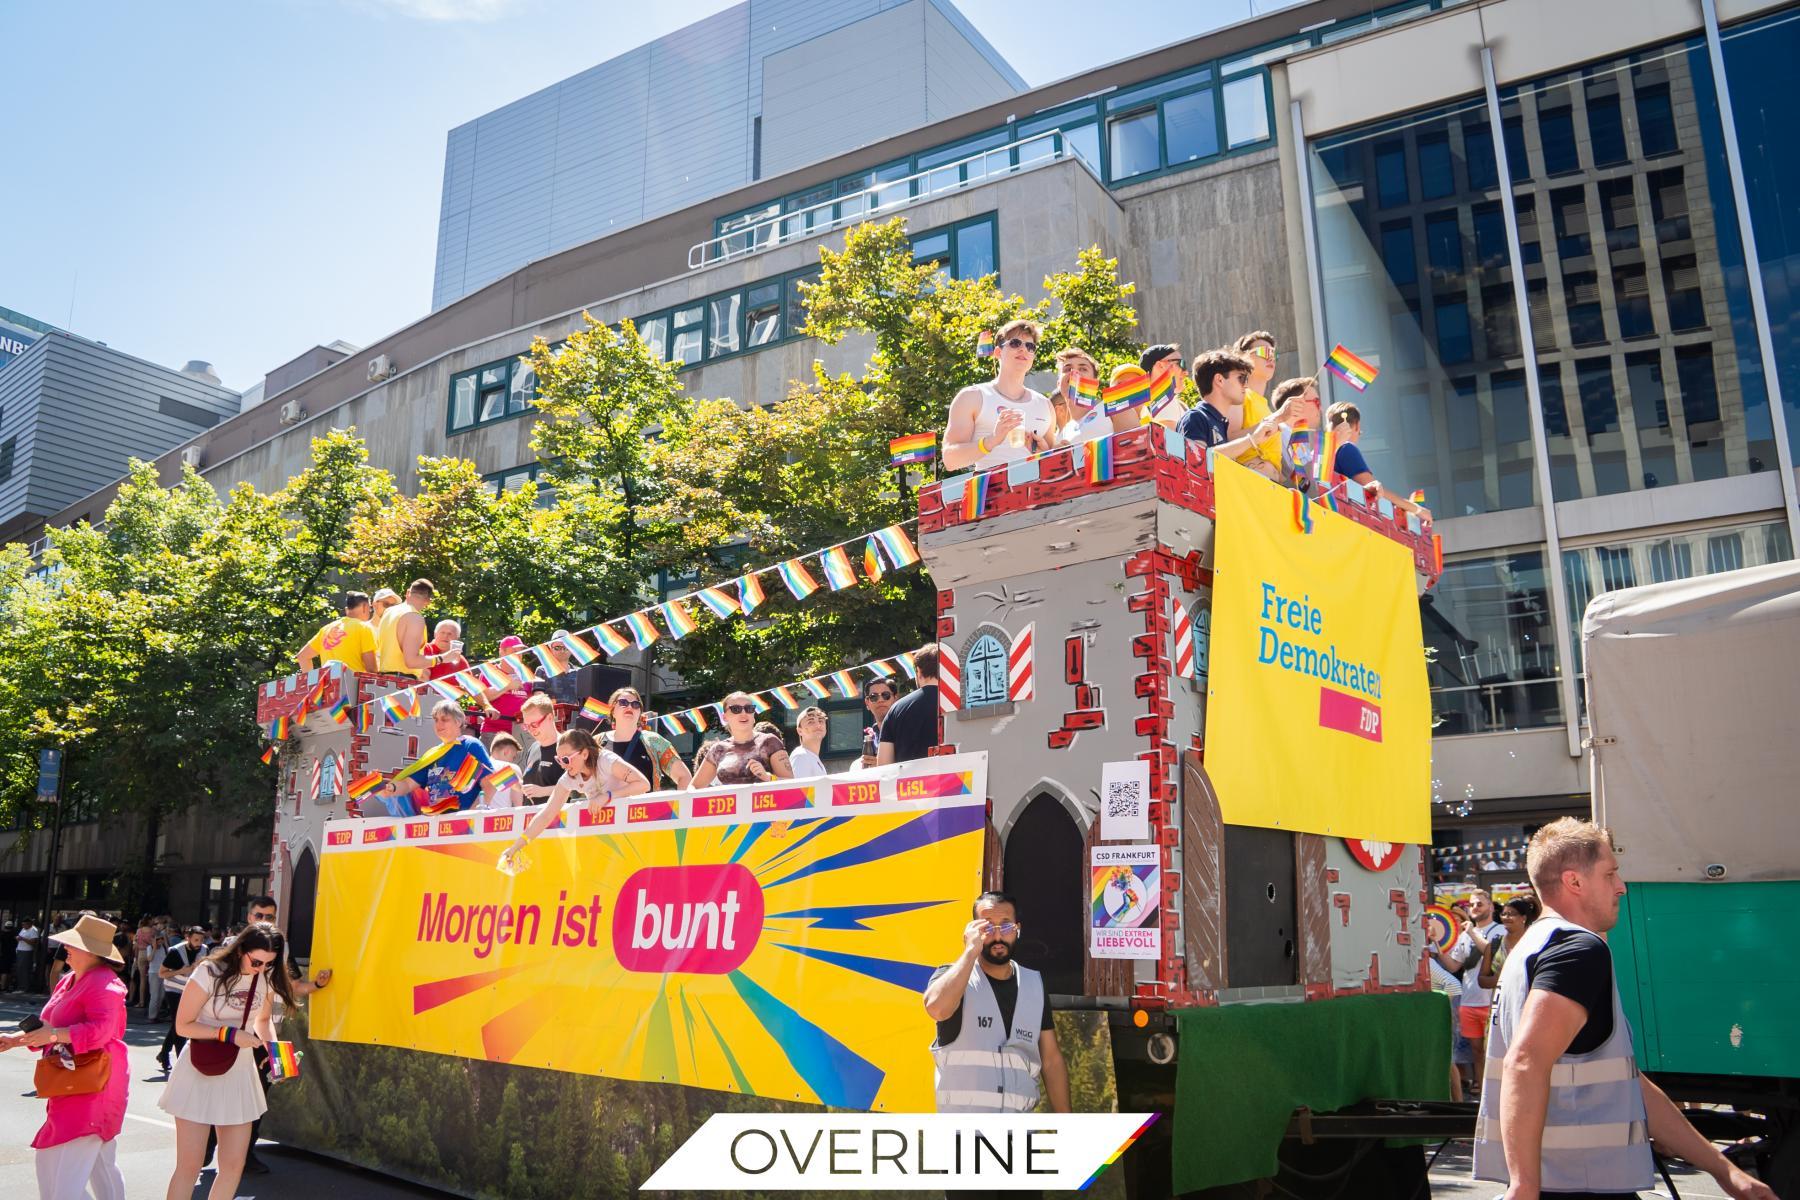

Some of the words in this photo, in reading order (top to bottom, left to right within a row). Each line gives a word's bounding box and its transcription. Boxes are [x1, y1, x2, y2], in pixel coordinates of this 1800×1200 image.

[0, 336, 30, 355] NB
[1262, 583, 1322, 635] Freie
[1258, 626, 1381, 699] Demokraten
[1359, 706, 1379, 734] FDP
[848, 784, 877, 803] FDP
[899, 780, 927, 797] LiSL
[708, 797, 734, 814] FDP
[753, 794, 776, 809] LiSL
[591, 809, 614, 824] FDP
[629, 806, 649, 820] LiSL
[413, 824, 428, 837] FDP
[440, 823, 453, 834] LiSL
[493, 816, 512, 831] FDP
[336, 832, 351, 844] FDP
[1096, 852, 1110, 860] CSD
[1112, 851, 1155, 860] FRANKFURT
[417, 892, 541, 959] Morgen
[552, 890, 602, 948] ist
[631, 888, 740, 951] bunt
[1097, 937, 1156, 948] LIEBEVOLL
[977, 1016, 993, 1028] 167
